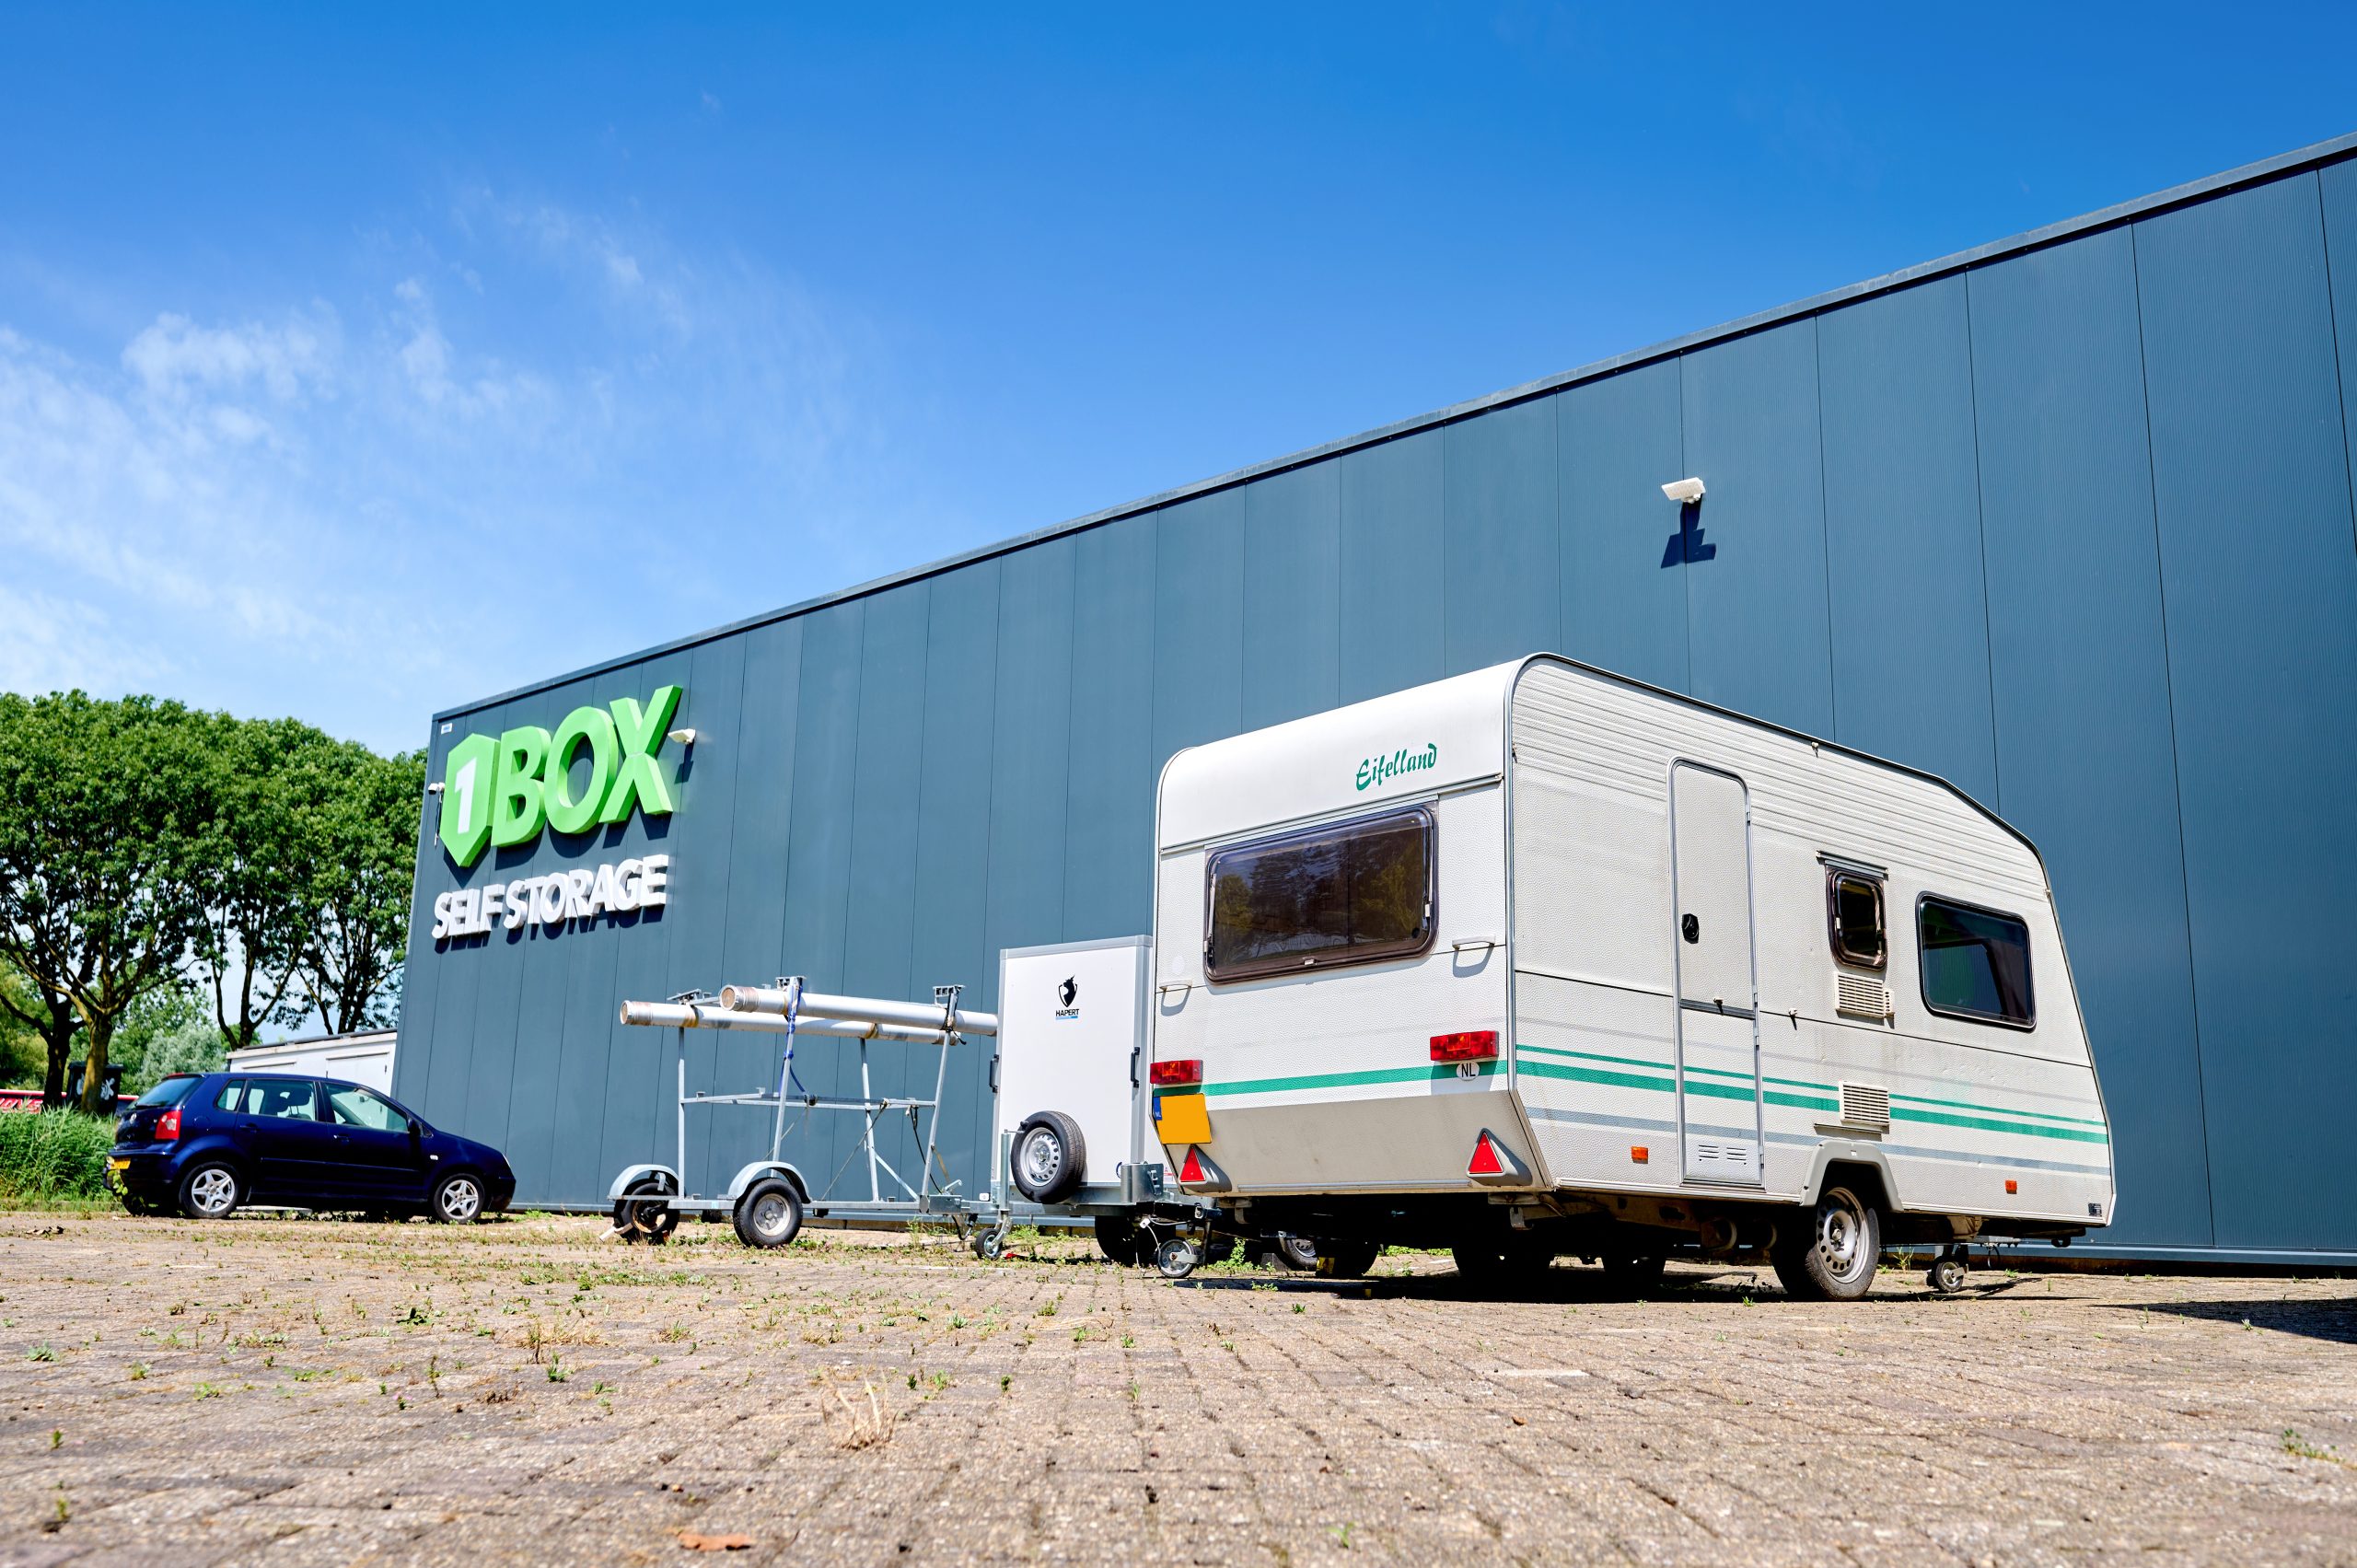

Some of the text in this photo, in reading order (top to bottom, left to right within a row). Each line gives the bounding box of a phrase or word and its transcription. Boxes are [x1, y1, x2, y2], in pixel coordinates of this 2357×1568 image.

[1356, 743, 1437, 791] Eifelland
[1055, 1008, 1079, 1016] HAPERT
[1461, 1063, 1476, 1077] NL
